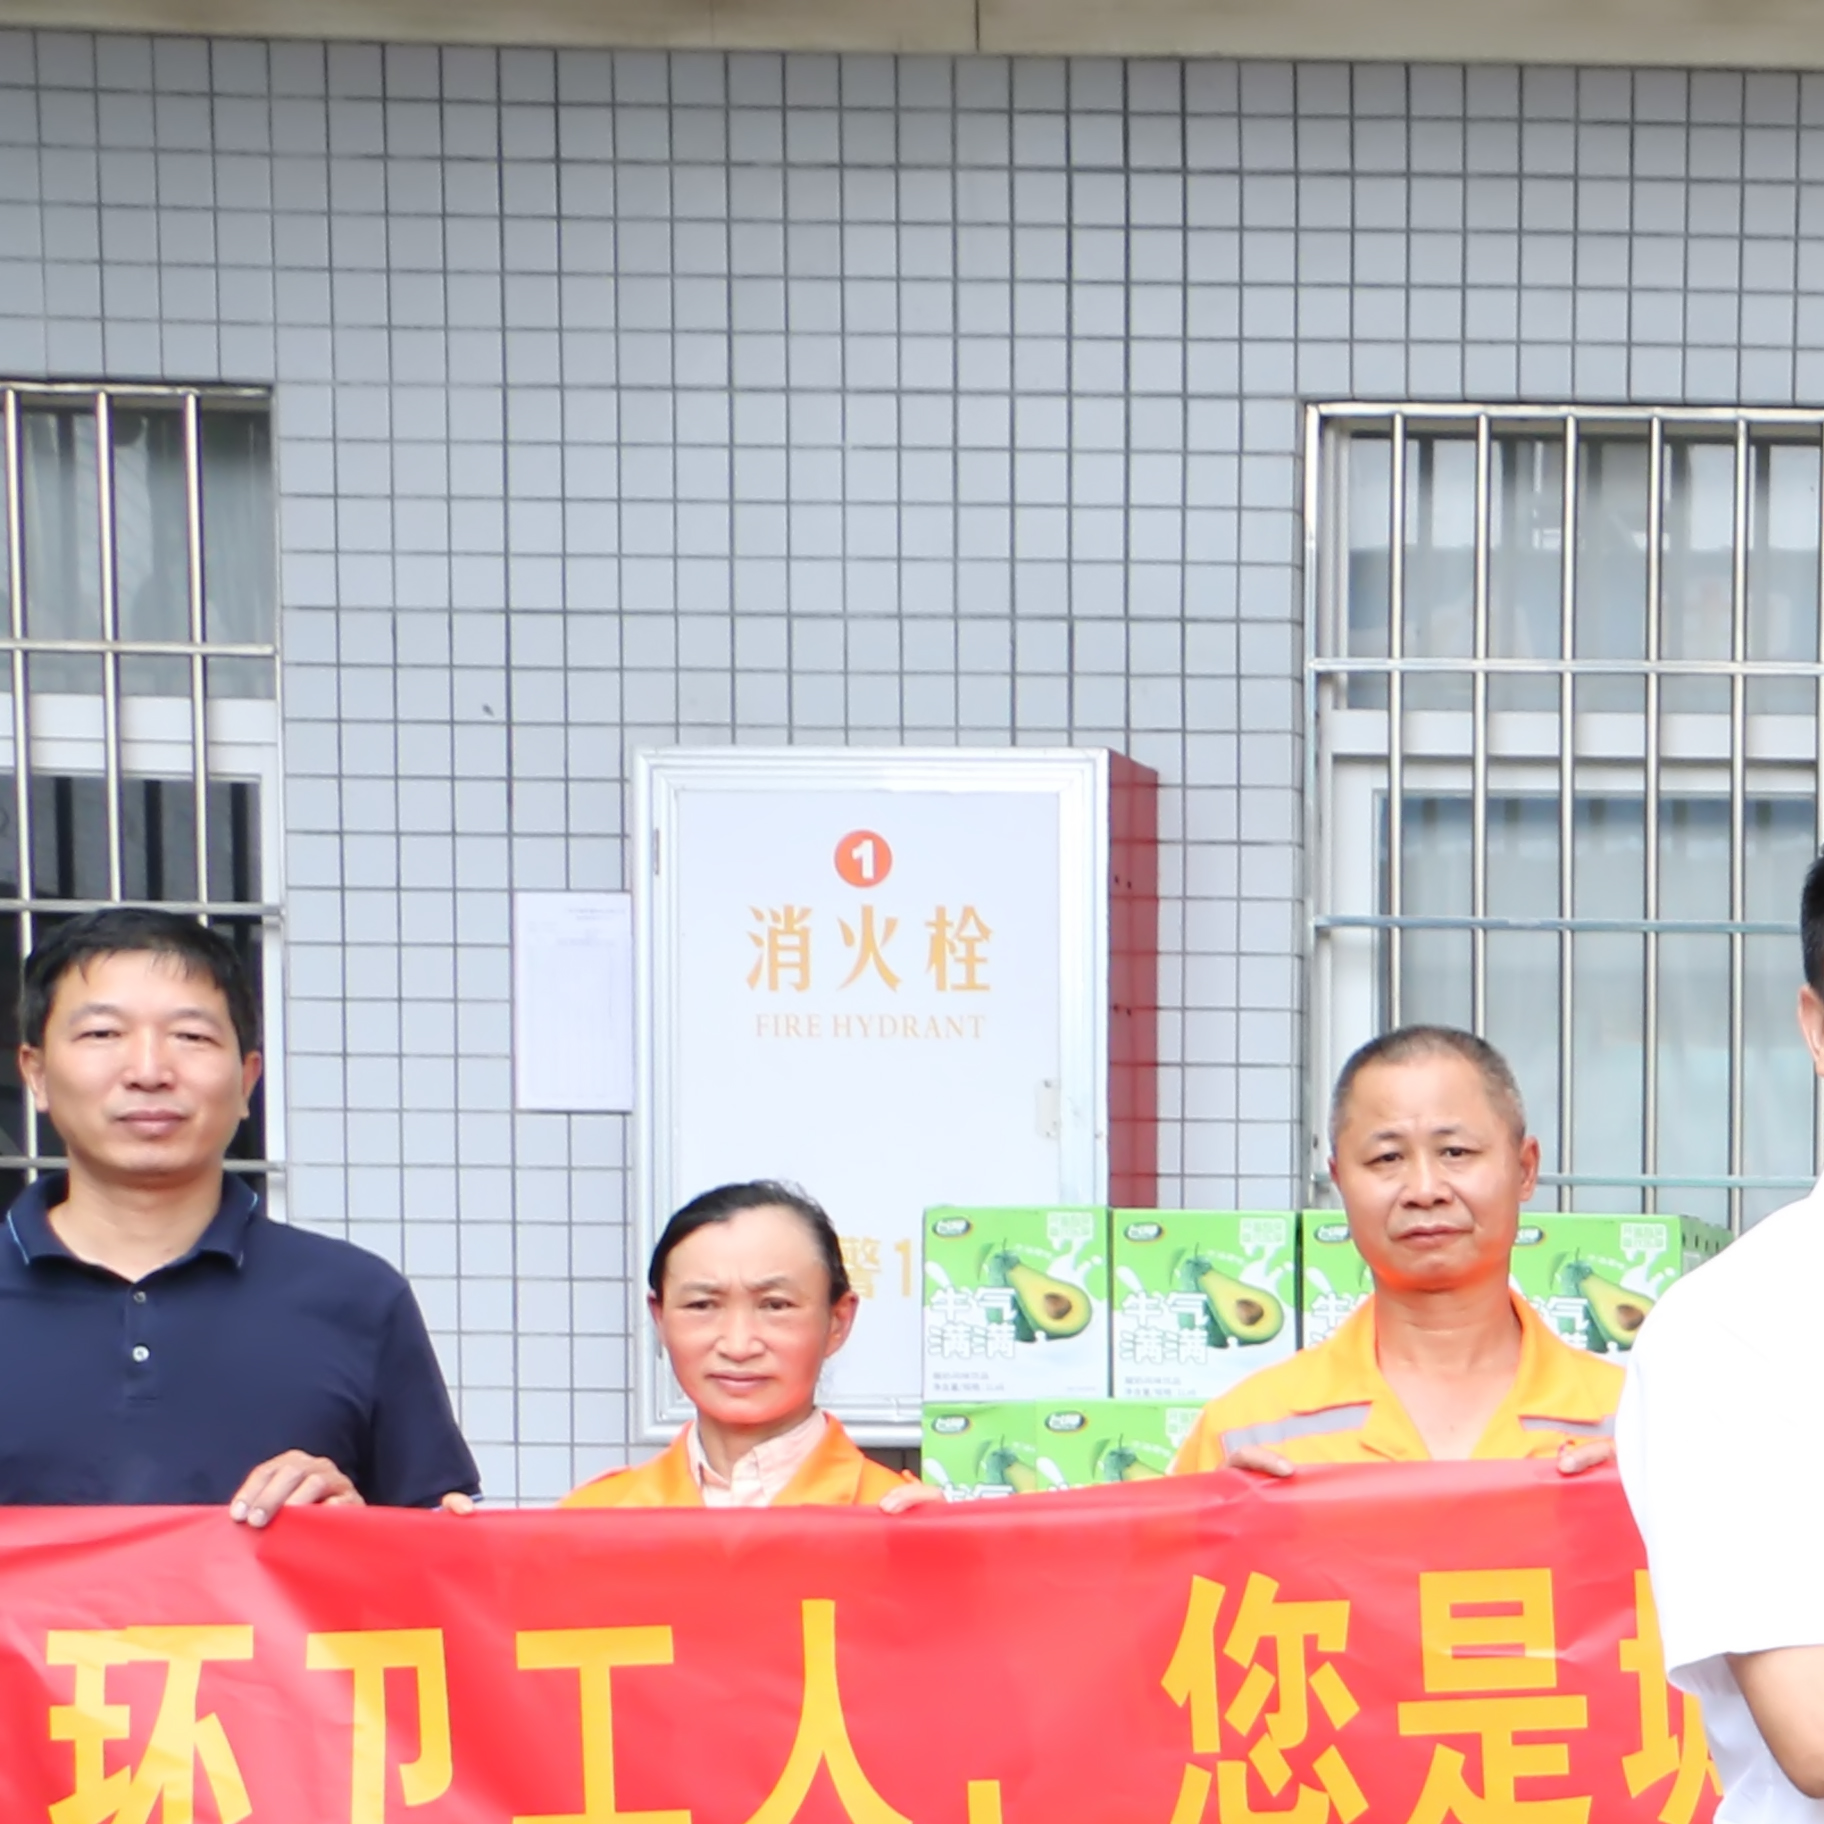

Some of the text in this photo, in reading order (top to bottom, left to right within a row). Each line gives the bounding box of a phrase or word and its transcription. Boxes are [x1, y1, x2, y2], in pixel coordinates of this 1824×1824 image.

[746, 903, 993, 993] 消火栓
[756, 1014, 986, 1039] FIRE HYDRANT
